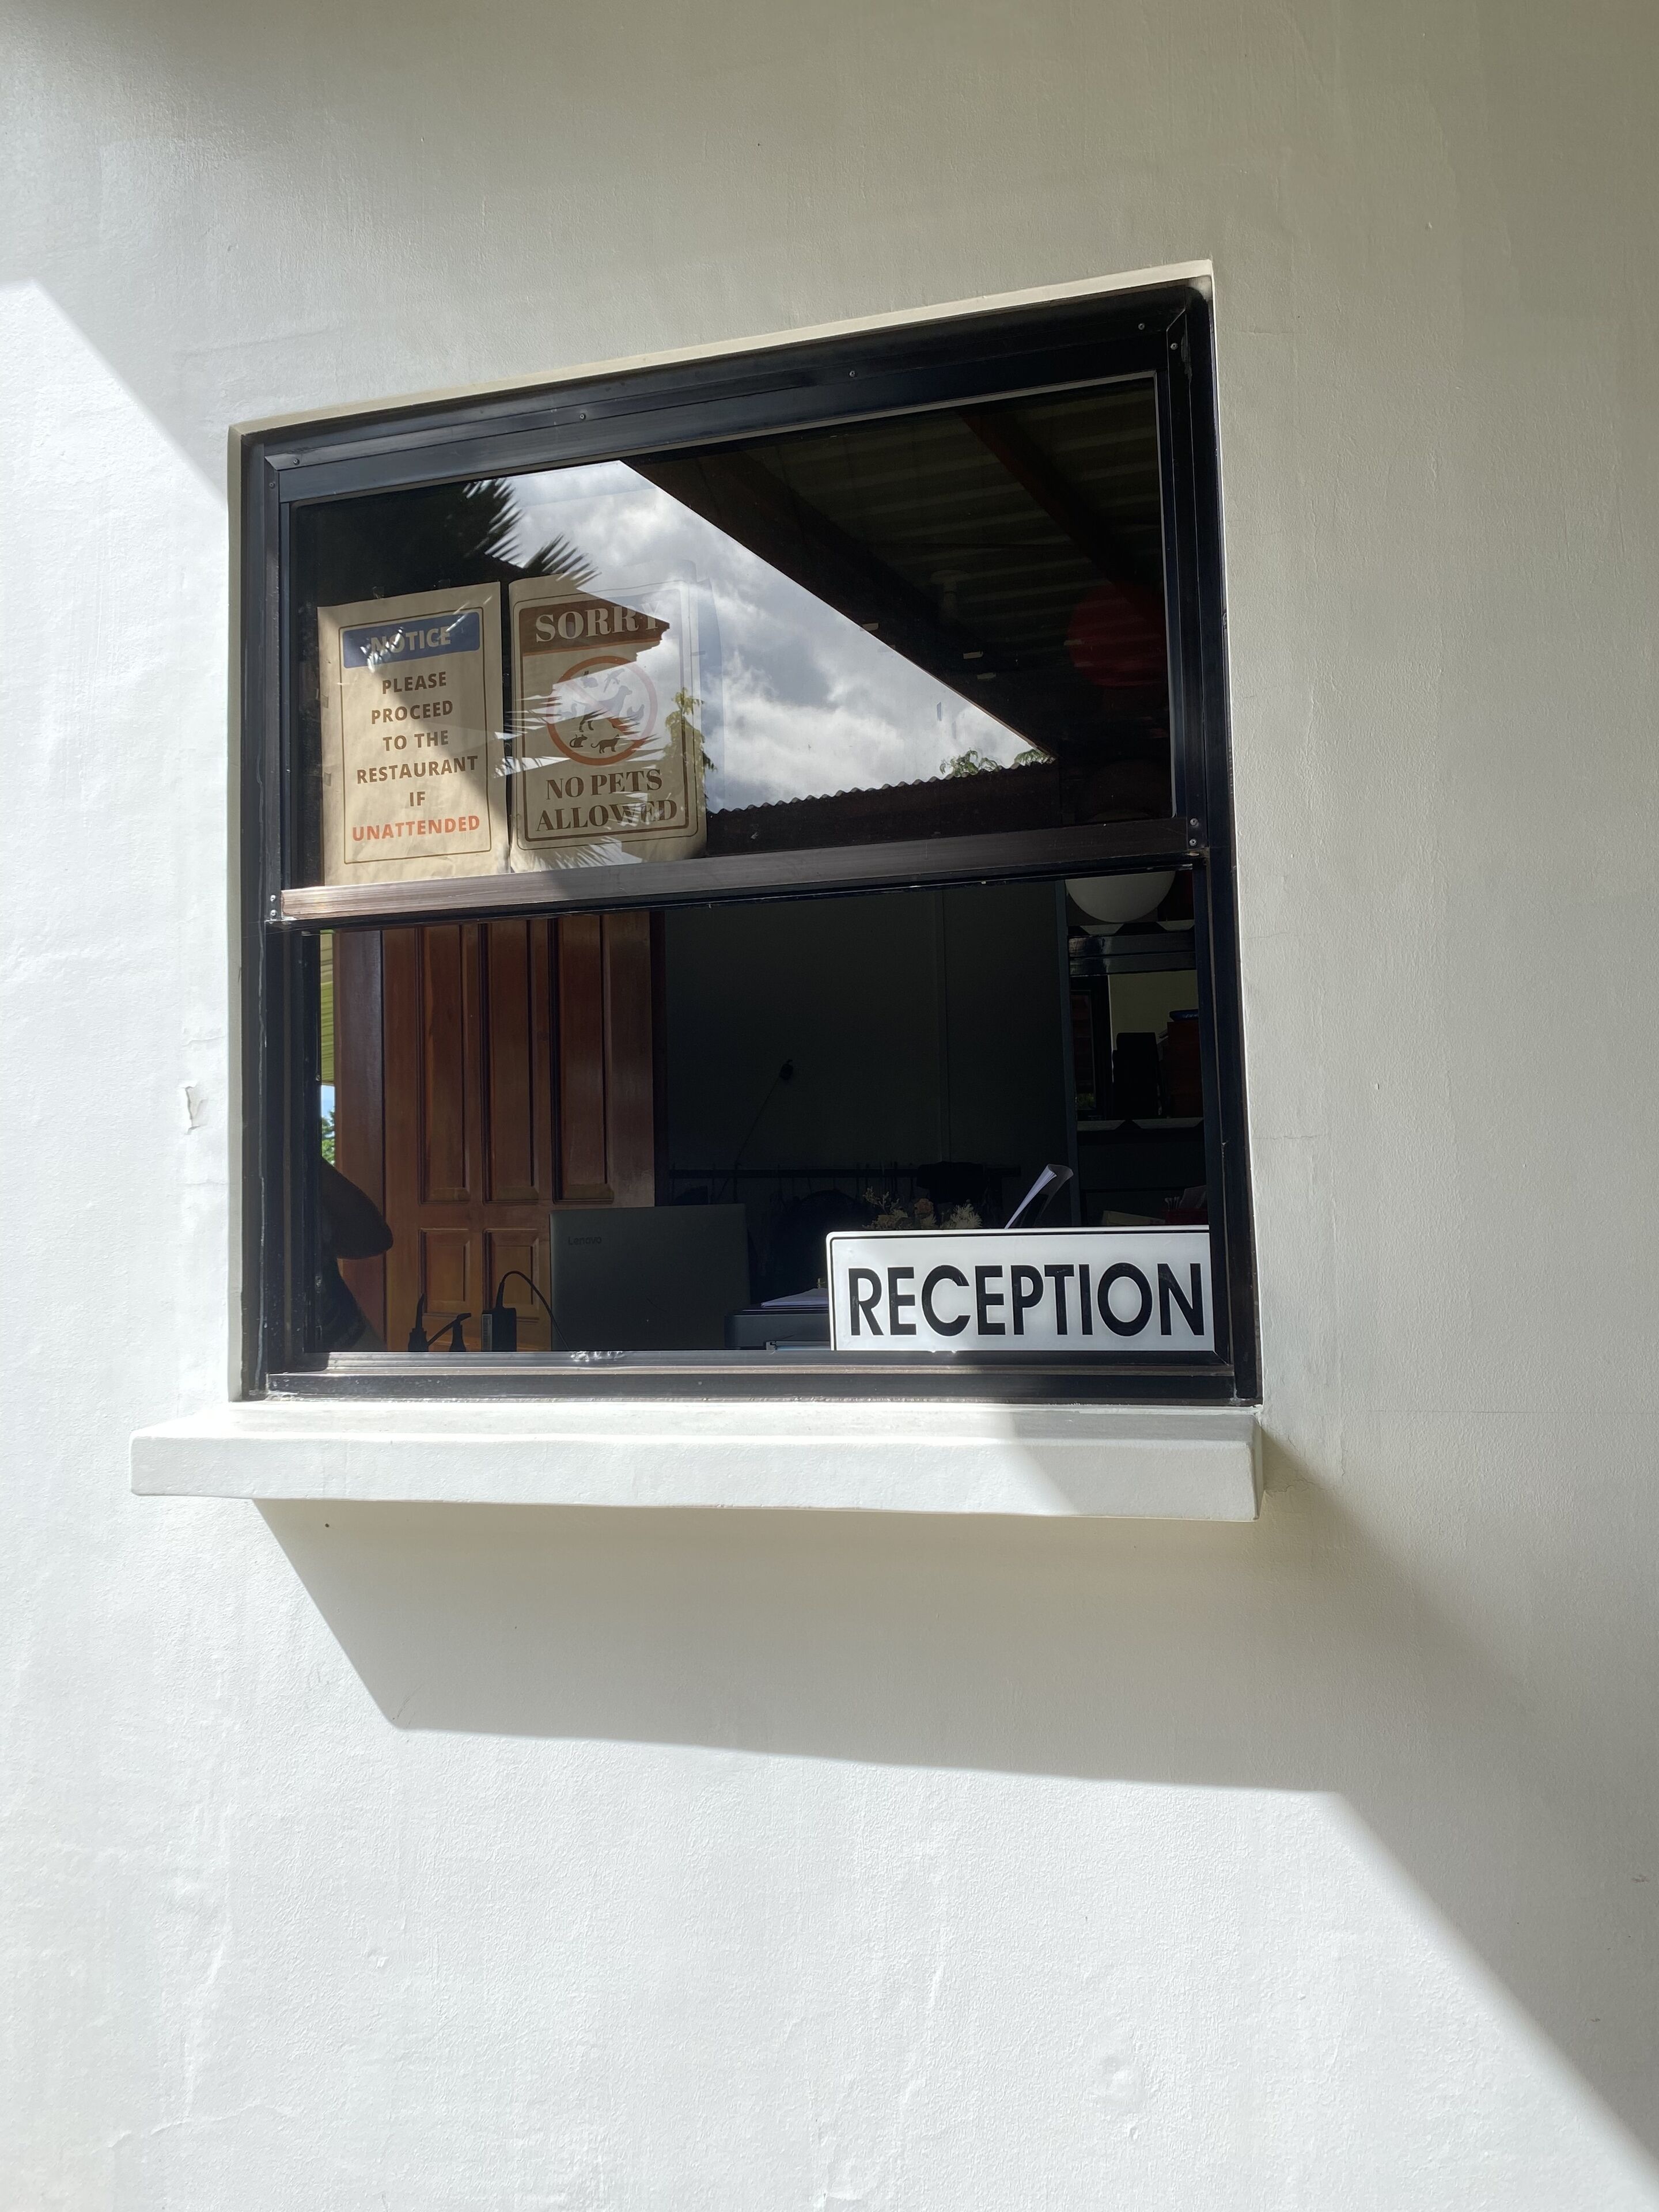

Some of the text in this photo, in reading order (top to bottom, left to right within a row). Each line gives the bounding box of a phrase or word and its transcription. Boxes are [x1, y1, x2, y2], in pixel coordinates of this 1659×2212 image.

[535, 600, 661, 643] SORRY
[370, 626, 451, 655] NOTICE
[382, 671, 446, 695] PLEASE
[371, 700, 453, 725] PROCEED
[382, 730, 449, 751] TO THE
[357, 756, 478, 784] RESTAURANT
[546, 769, 662, 800] NO PETS
[410, 791, 426, 806] IF
[352, 815, 480, 842] UNATTENDED
[536, 800, 677, 832] ALLOWED
[568, 1236, 603, 1245] Lenovo
[847, 1262, 1206, 1338] RECEPTION
